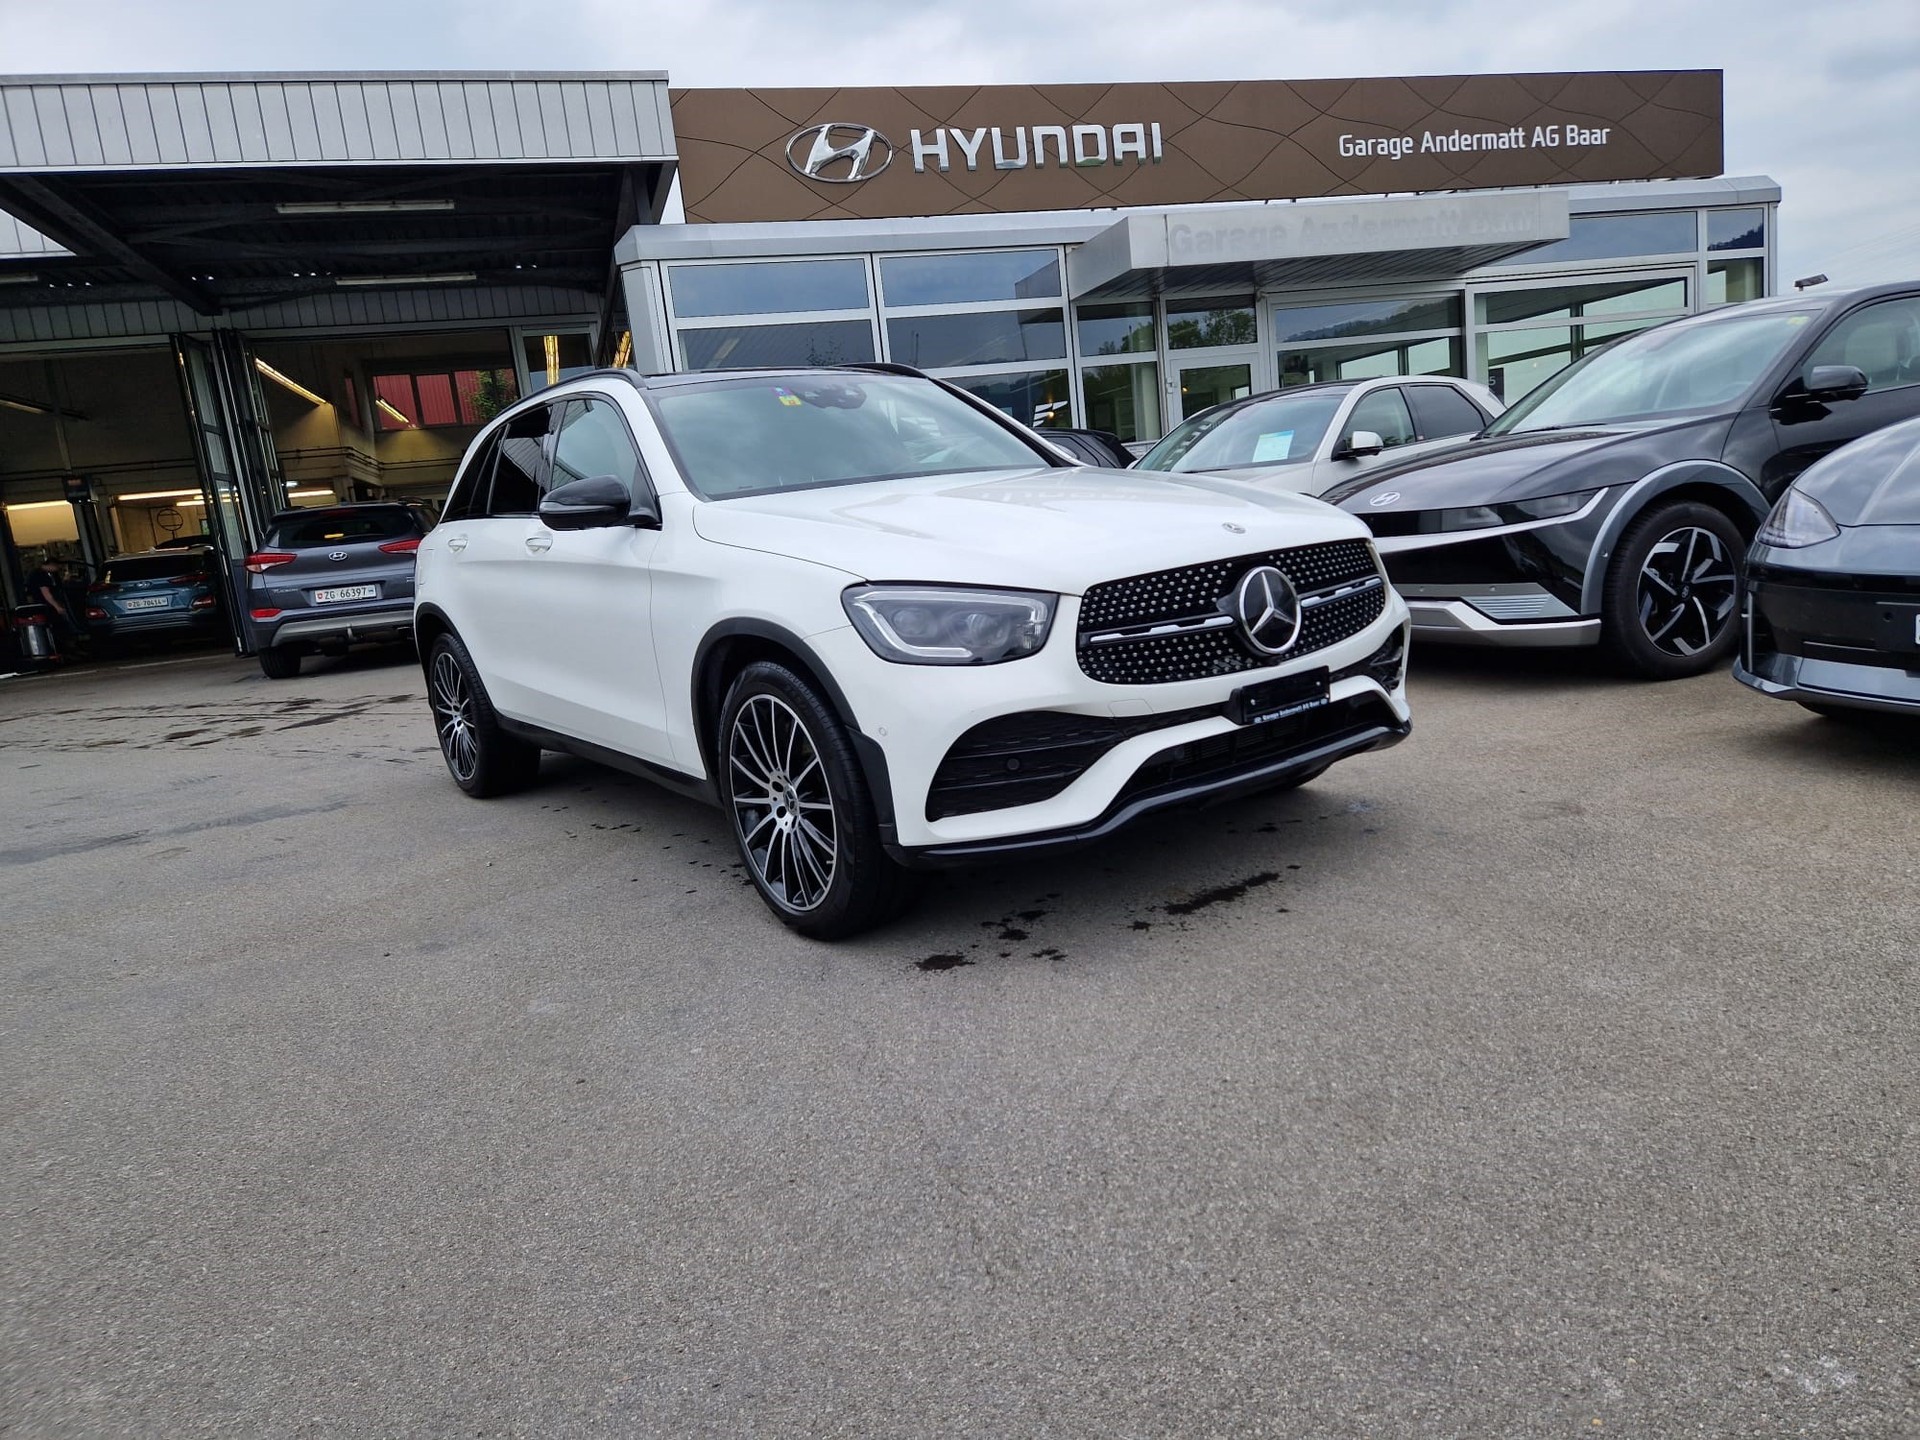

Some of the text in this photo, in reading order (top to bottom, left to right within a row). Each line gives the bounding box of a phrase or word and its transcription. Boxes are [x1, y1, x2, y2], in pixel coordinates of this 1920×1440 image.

[910, 122, 1163, 173] HYUNDAI
[1338, 124, 1611, 160] Garage Andermatt AG Baar
[324, 587, 367, 600] ZG 66397
